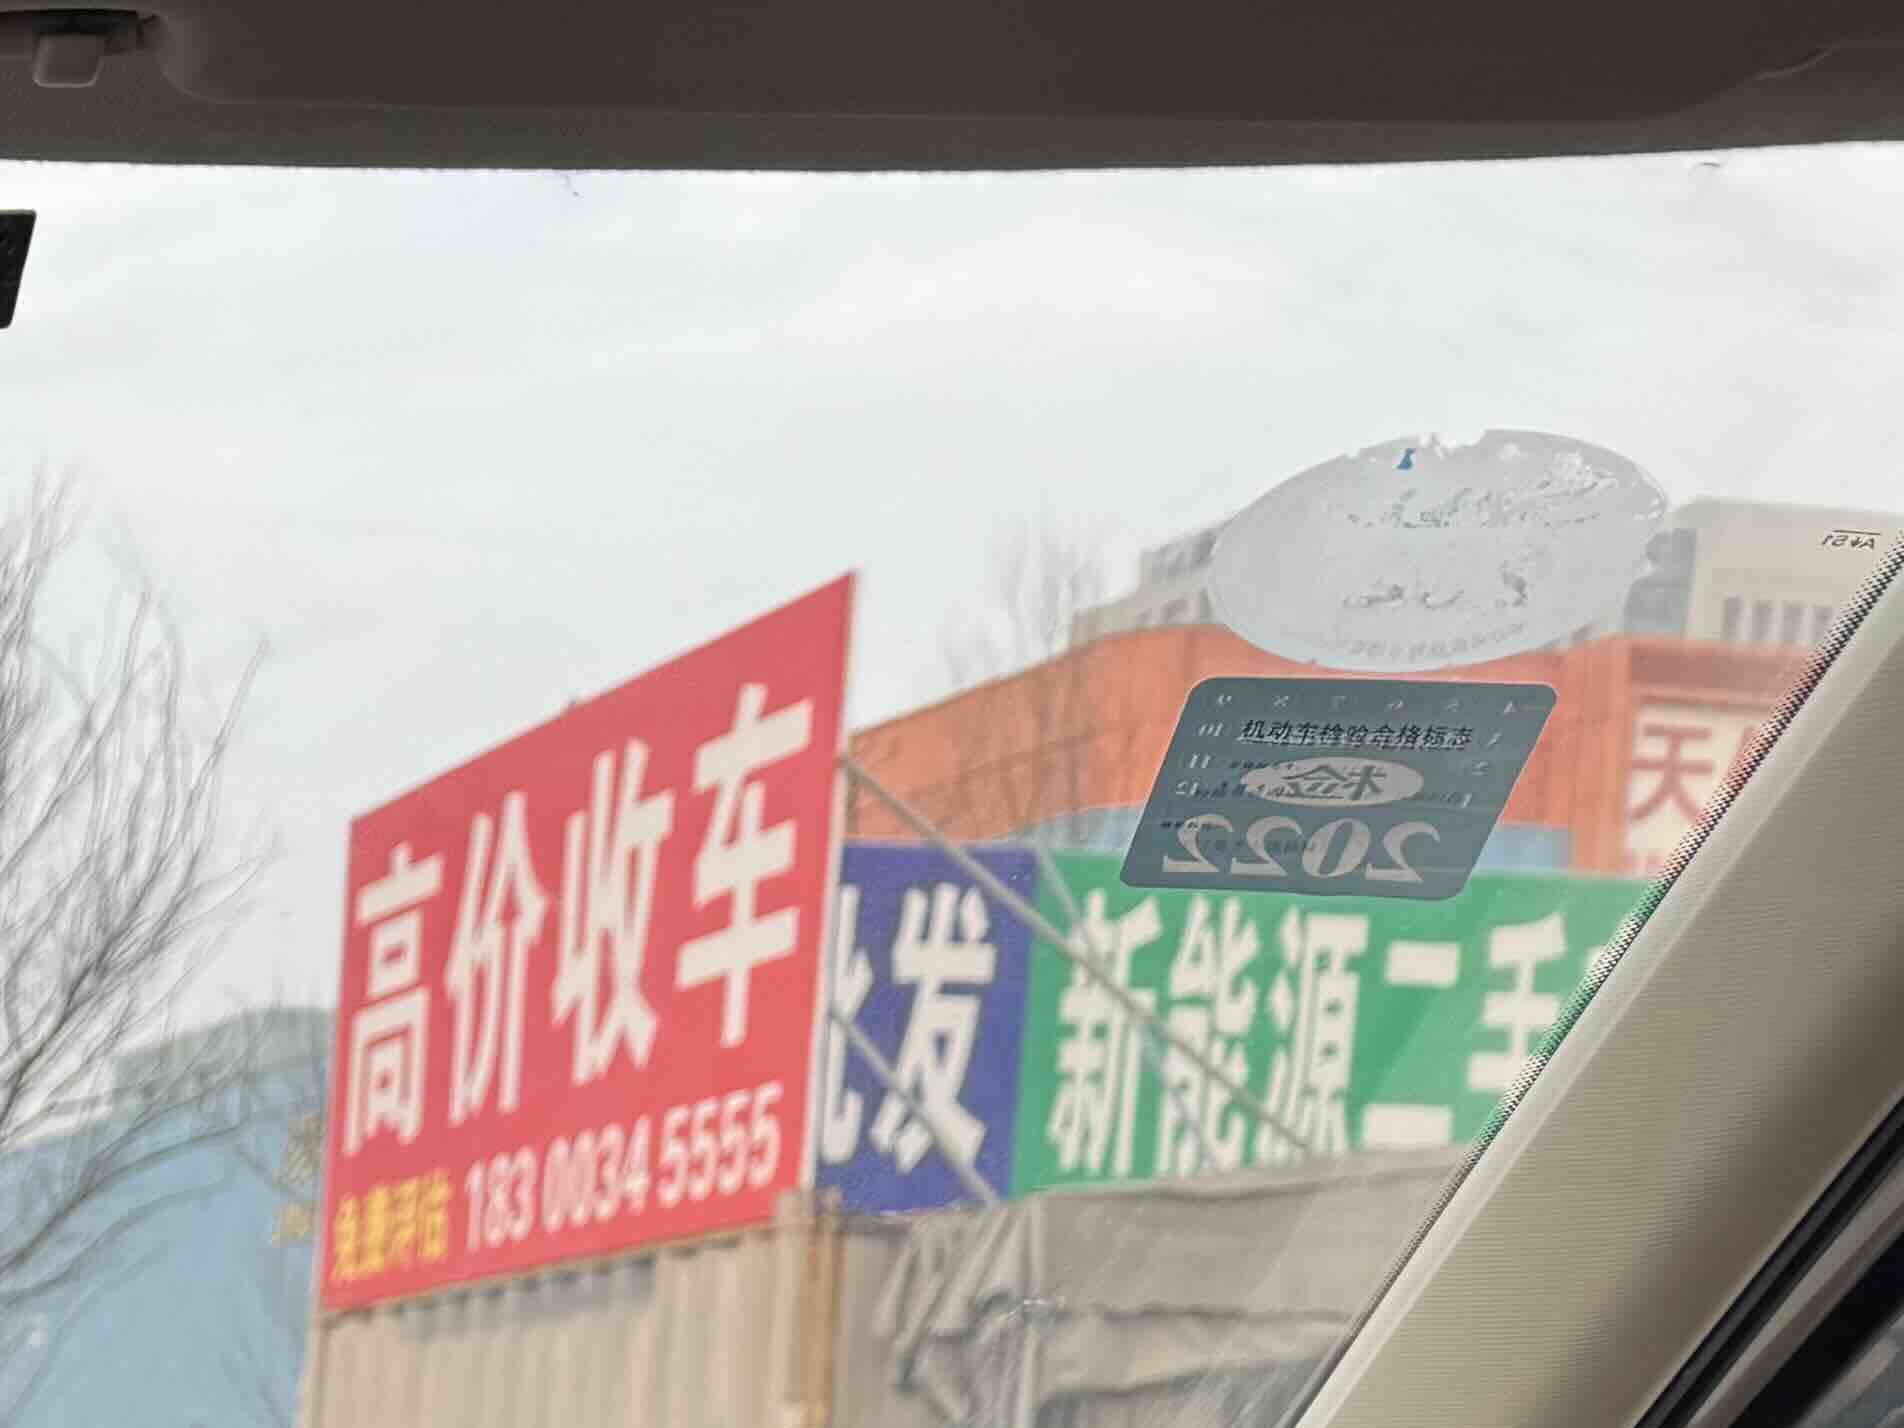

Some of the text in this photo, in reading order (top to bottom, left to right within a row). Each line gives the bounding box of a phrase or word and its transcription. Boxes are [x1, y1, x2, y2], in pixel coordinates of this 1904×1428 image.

[1629, 720, 1770, 828] 天
[340, 684, 815, 1157] 高价收车
[1046, 886, 1604, 1179] 新能源二手
[464, 1146, 538, 1254] 183
[541, 1114, 653, 1233] 0034
[654, 1083, 784, 1209] 5555
